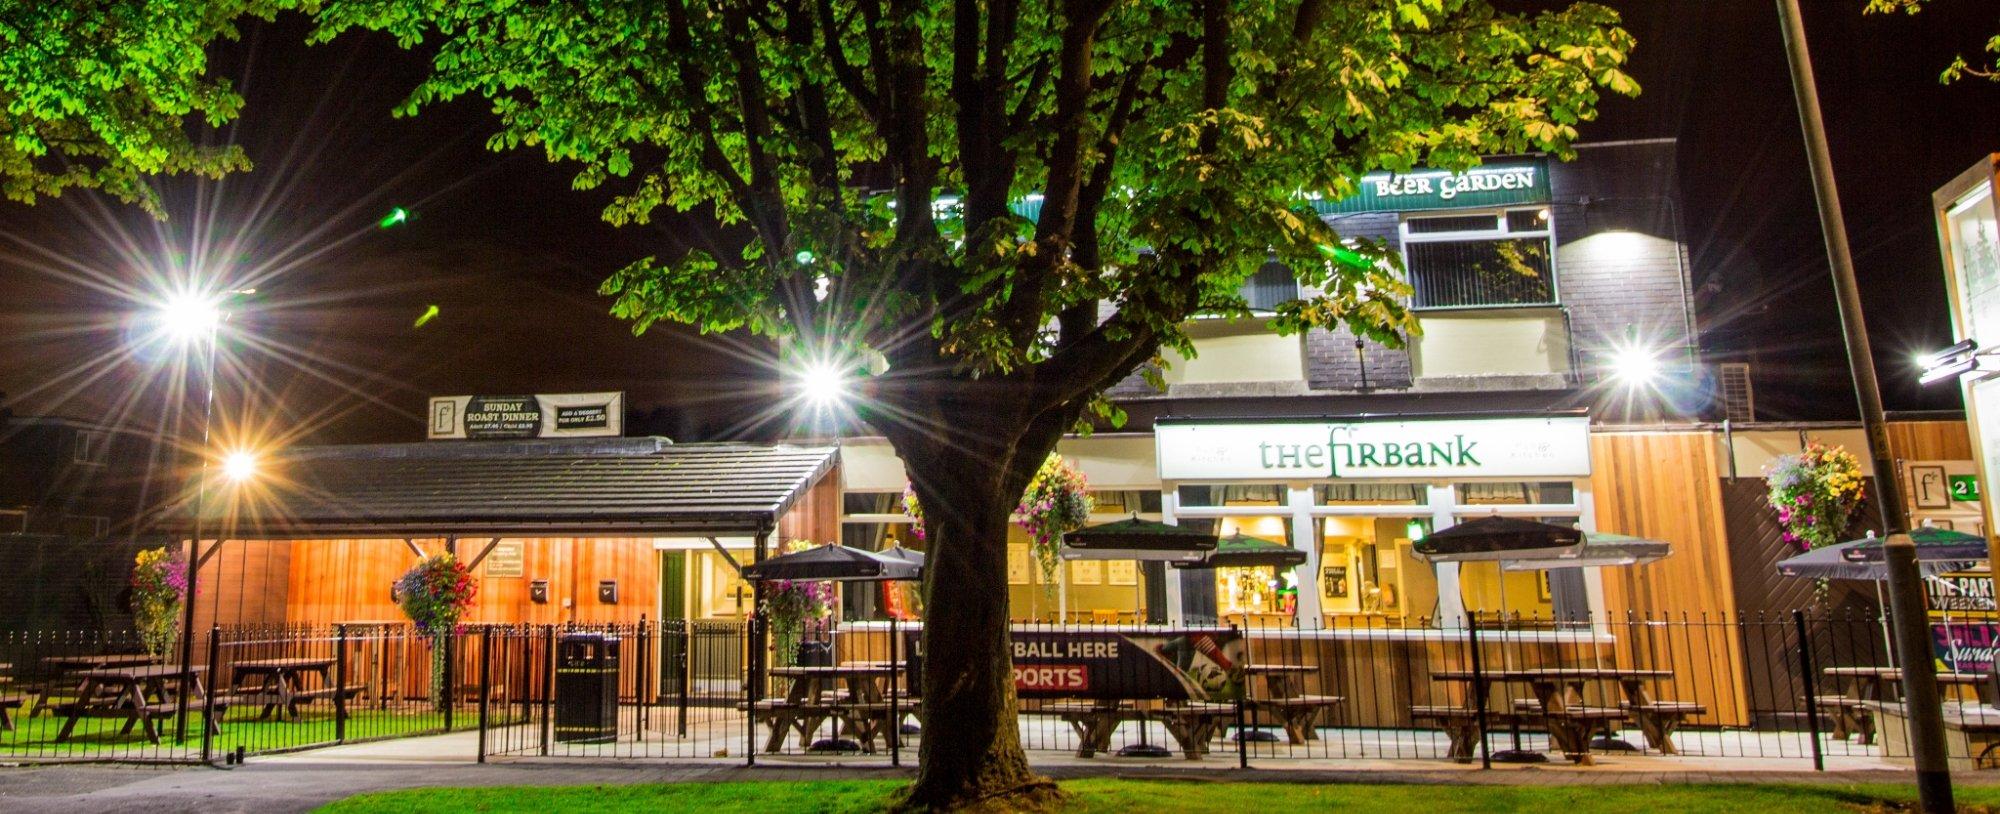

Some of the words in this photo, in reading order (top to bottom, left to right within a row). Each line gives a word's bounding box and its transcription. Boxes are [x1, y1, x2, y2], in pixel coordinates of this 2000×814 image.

[484, 403, 523, 411] SUNDAY
[467, 413, 499, 421] ROAST
[502, 412, 539, 421] DINNER
[1959, 577, 1995, 597] PART
[1929, 596, 1997, 610] WEEKEN
[1010, 641, 1064, 658] BALL
[1067, 641, 1119, 658] HERE
[1014, 668, 1083, 687] PORTS
